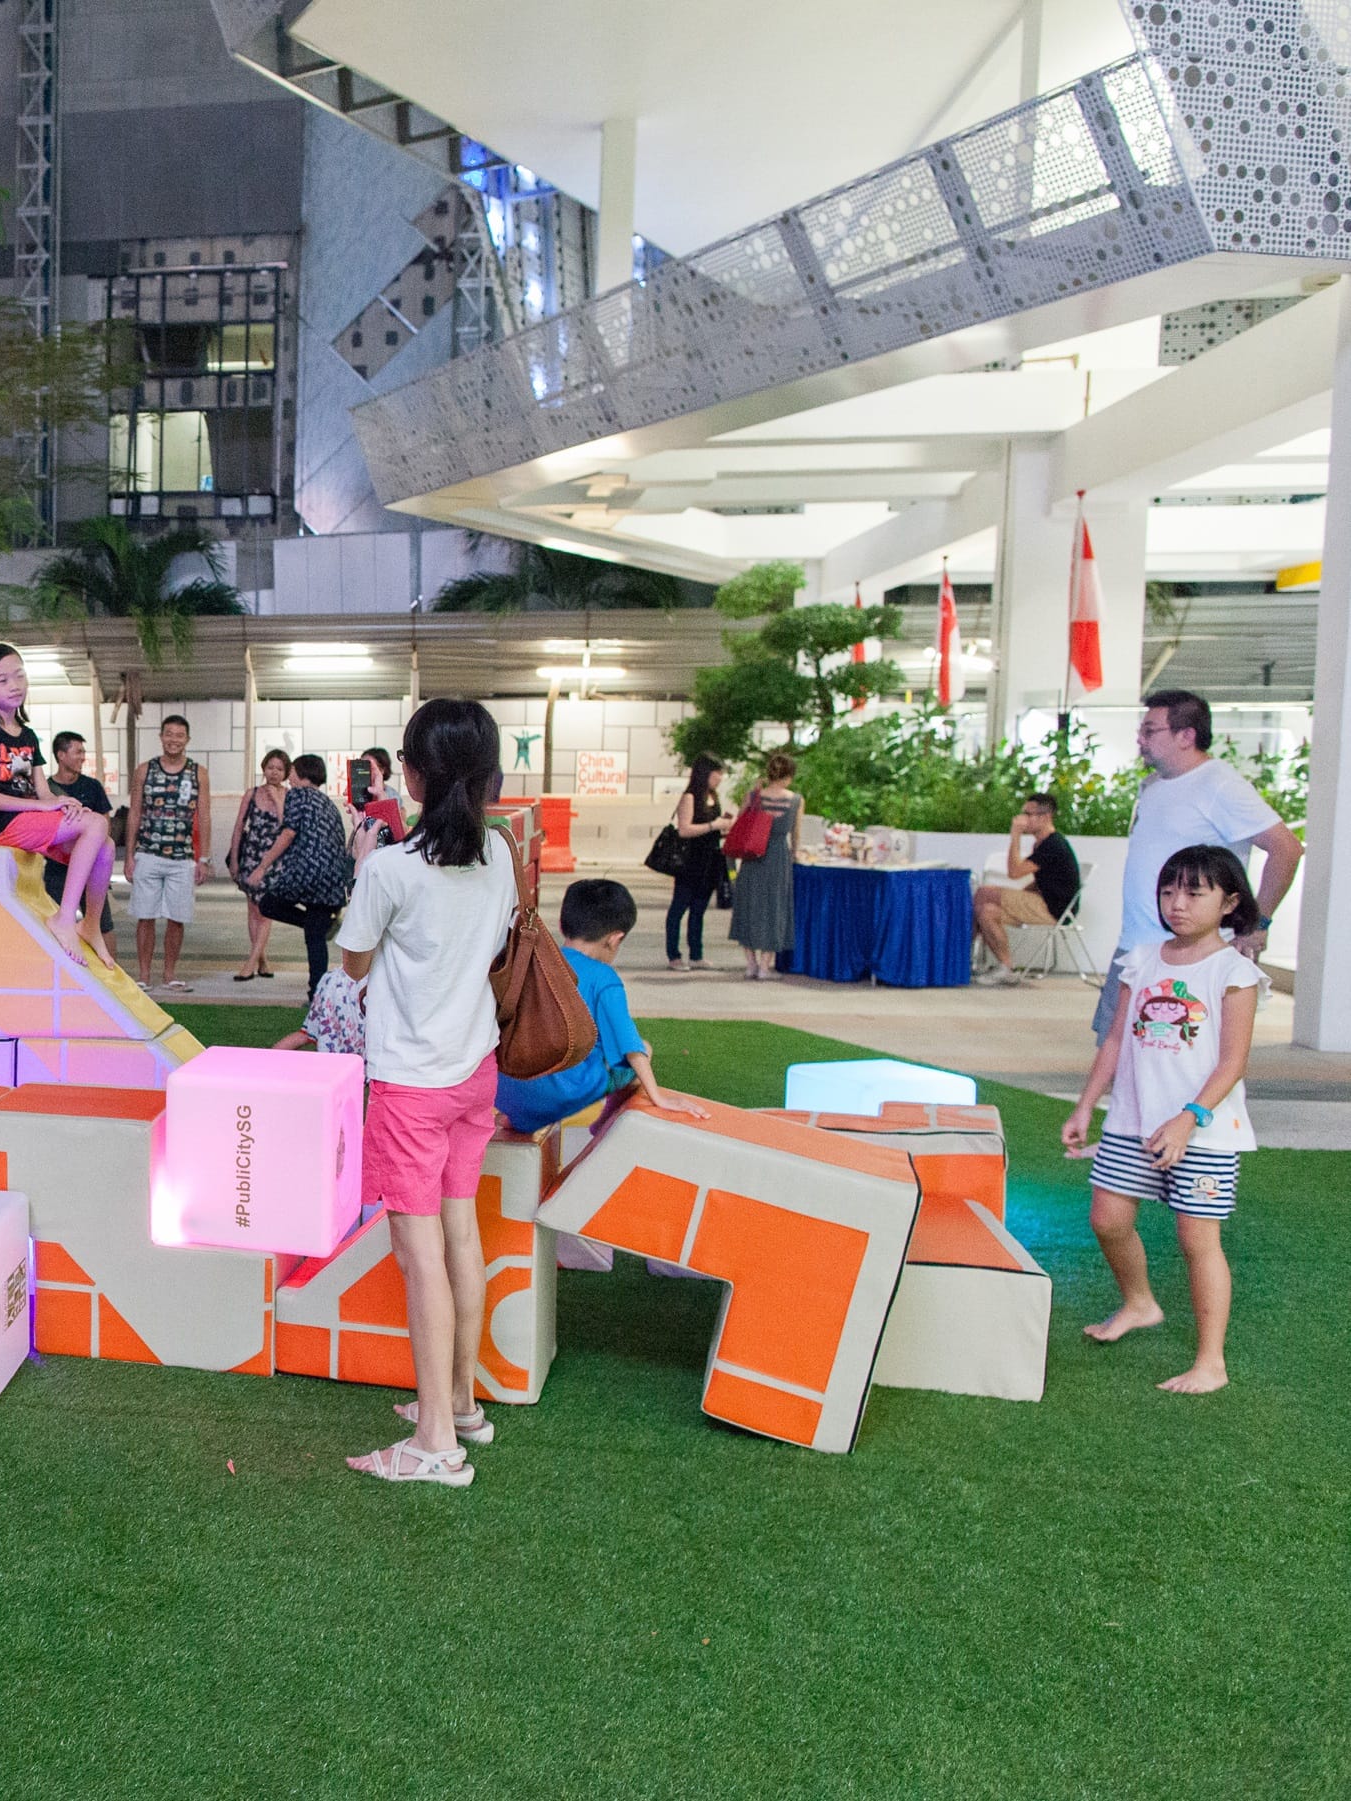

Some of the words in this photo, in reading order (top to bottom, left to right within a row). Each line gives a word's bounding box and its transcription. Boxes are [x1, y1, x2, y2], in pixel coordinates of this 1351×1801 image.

[578, 752, 615, 768] China
[578, 767, 628, 785] Cultural
[236, 1105, 255, 1228] #PubliCitySG
